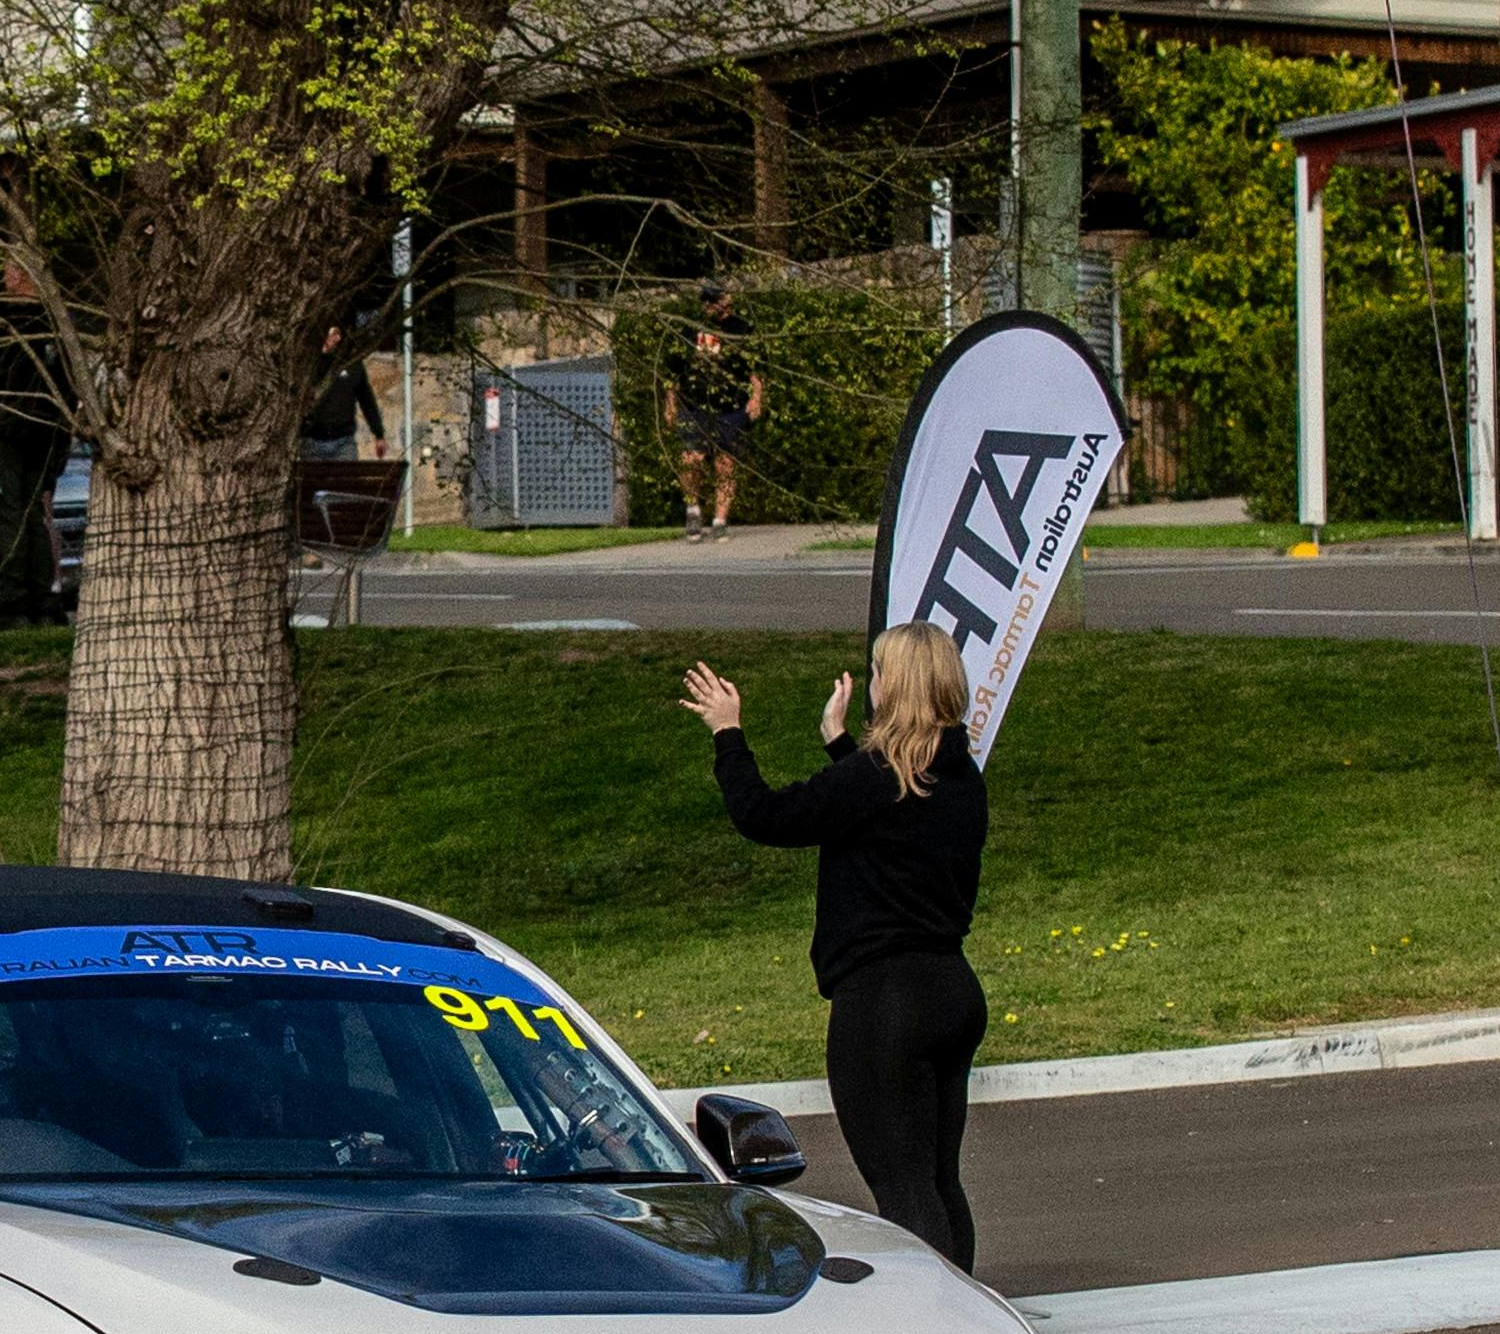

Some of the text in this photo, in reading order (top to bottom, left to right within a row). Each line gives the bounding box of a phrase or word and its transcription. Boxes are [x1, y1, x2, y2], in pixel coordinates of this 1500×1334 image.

[120, 930, 257, 955] ATR
[135, 954, 287, 969] TARMAC
[292, 957, 402, 977] RALLY
[423, 985, 589, 1051] 911
